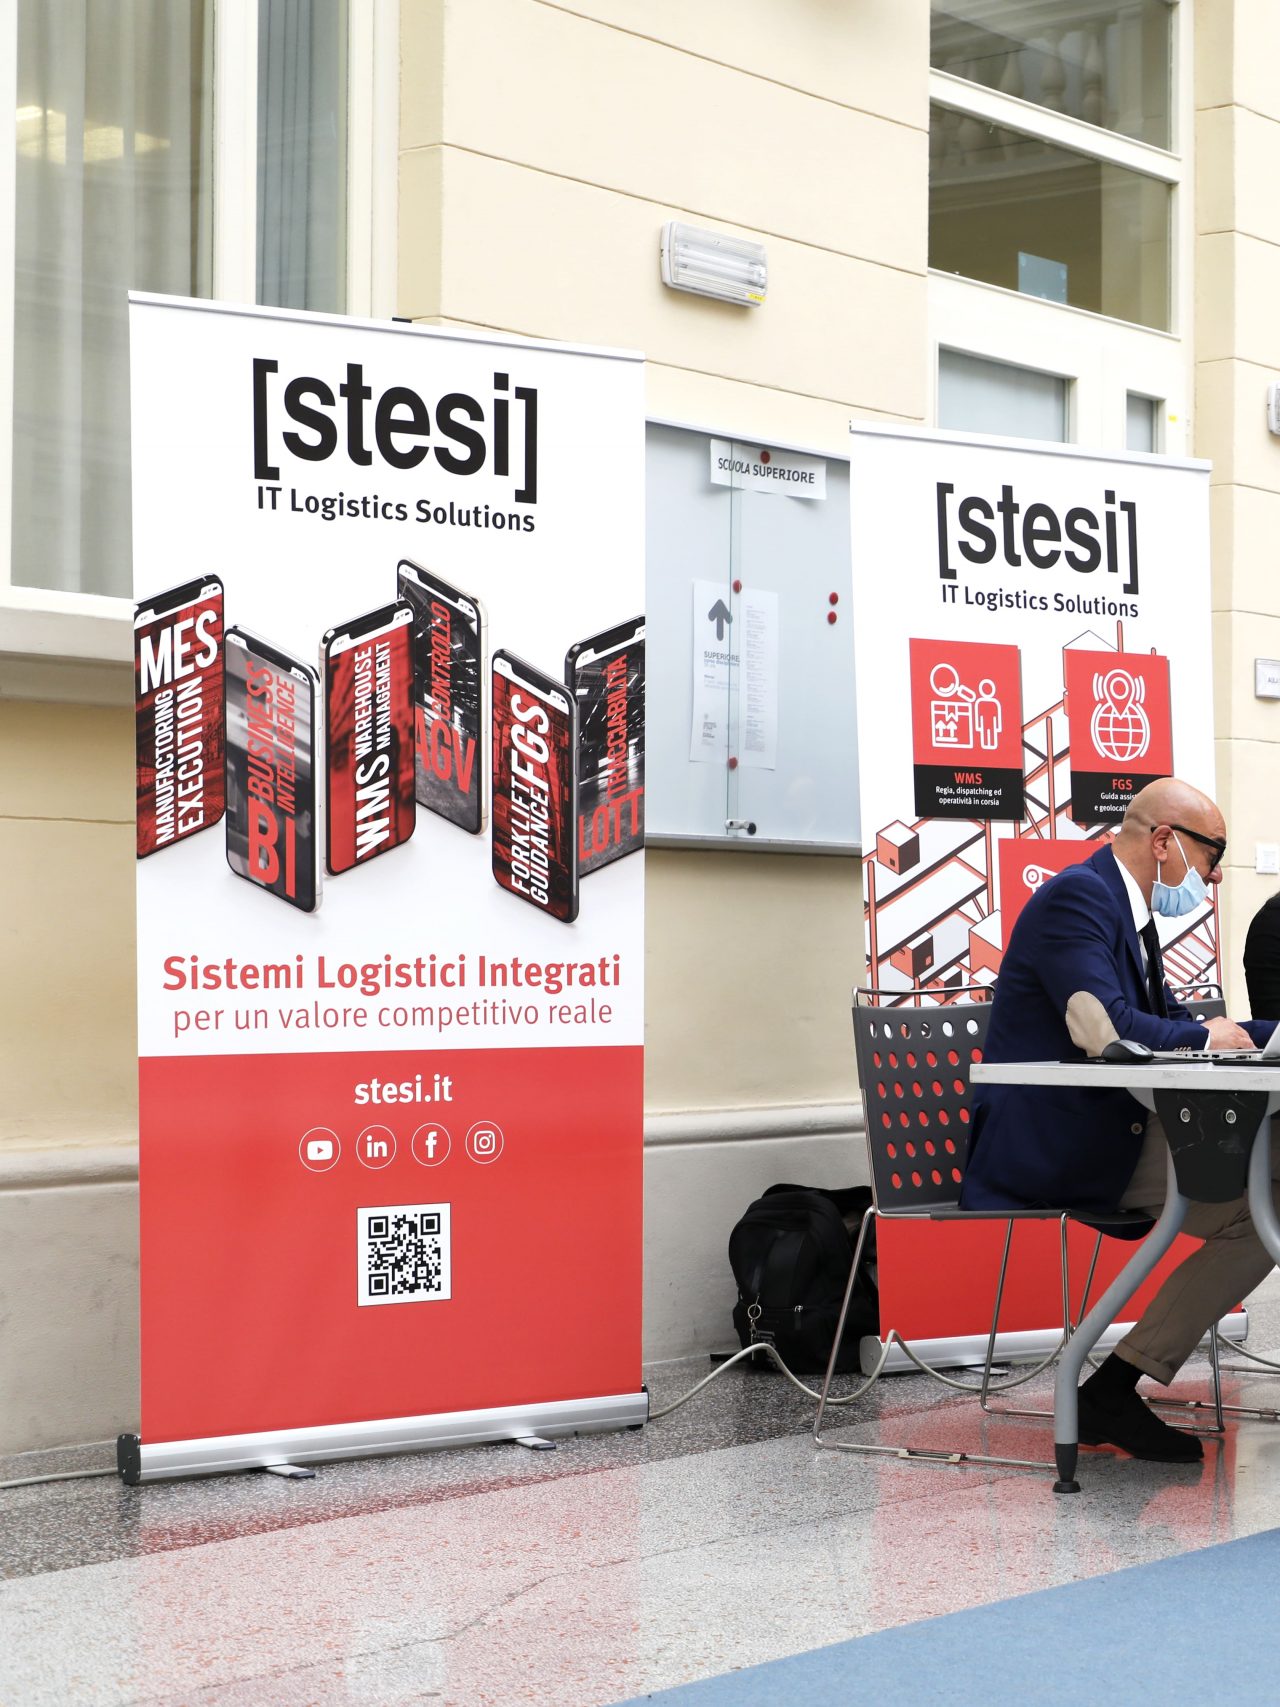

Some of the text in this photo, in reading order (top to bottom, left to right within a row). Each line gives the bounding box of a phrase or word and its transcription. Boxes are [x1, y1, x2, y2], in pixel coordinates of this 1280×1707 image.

[258, 486, 534, 532] IT Logistics Solutions
[718, 458, 815, 483] SCUOLA SUPERIORE
[942, 585, 1139, 617] IT Logistics Solutions
[140, 610, 218, 695] MES
[375, 640, 391, 747] MANAGEMENT
[431, 601, 451, 719] CONTROLLO
[246, 661, 274, 803] BUSINESS
[276, 675, 296, 814] INTELLIGENCE
[354, 646, 372, 761] WAREHOUSE
[510, 694, 549, 794] FGS
[155, 689, 175, 845] MANUFACTORING
[177, 676, 204, 834] EXECUTION
[416, 705, 476, 794] AGV
[935, 786, 1002, 796] Regia, dispatching ed
[954, 772, 983, 784] WMS
[1112, 778, 1133, 791] FGS
[355, 753, 391, 859] WMS
[511, 782, 531, 895] FORKLIFT
[939, 796, 972, 805] operatività
[973, 797, 979, 805] in
[1100, 792, 1119, 800] Guida
[1100, 804, 1128, 813] geolocali
[248, 795, 296, 899] BI
[530, 786, 549, 905] GUIDANCE
[163, 954, 620, 996] Sistemi Logistici Integrati
[174, 998, 612, 1037] per un valore competitivo reale
[355, 1073, 453, 1105] stesi.it
